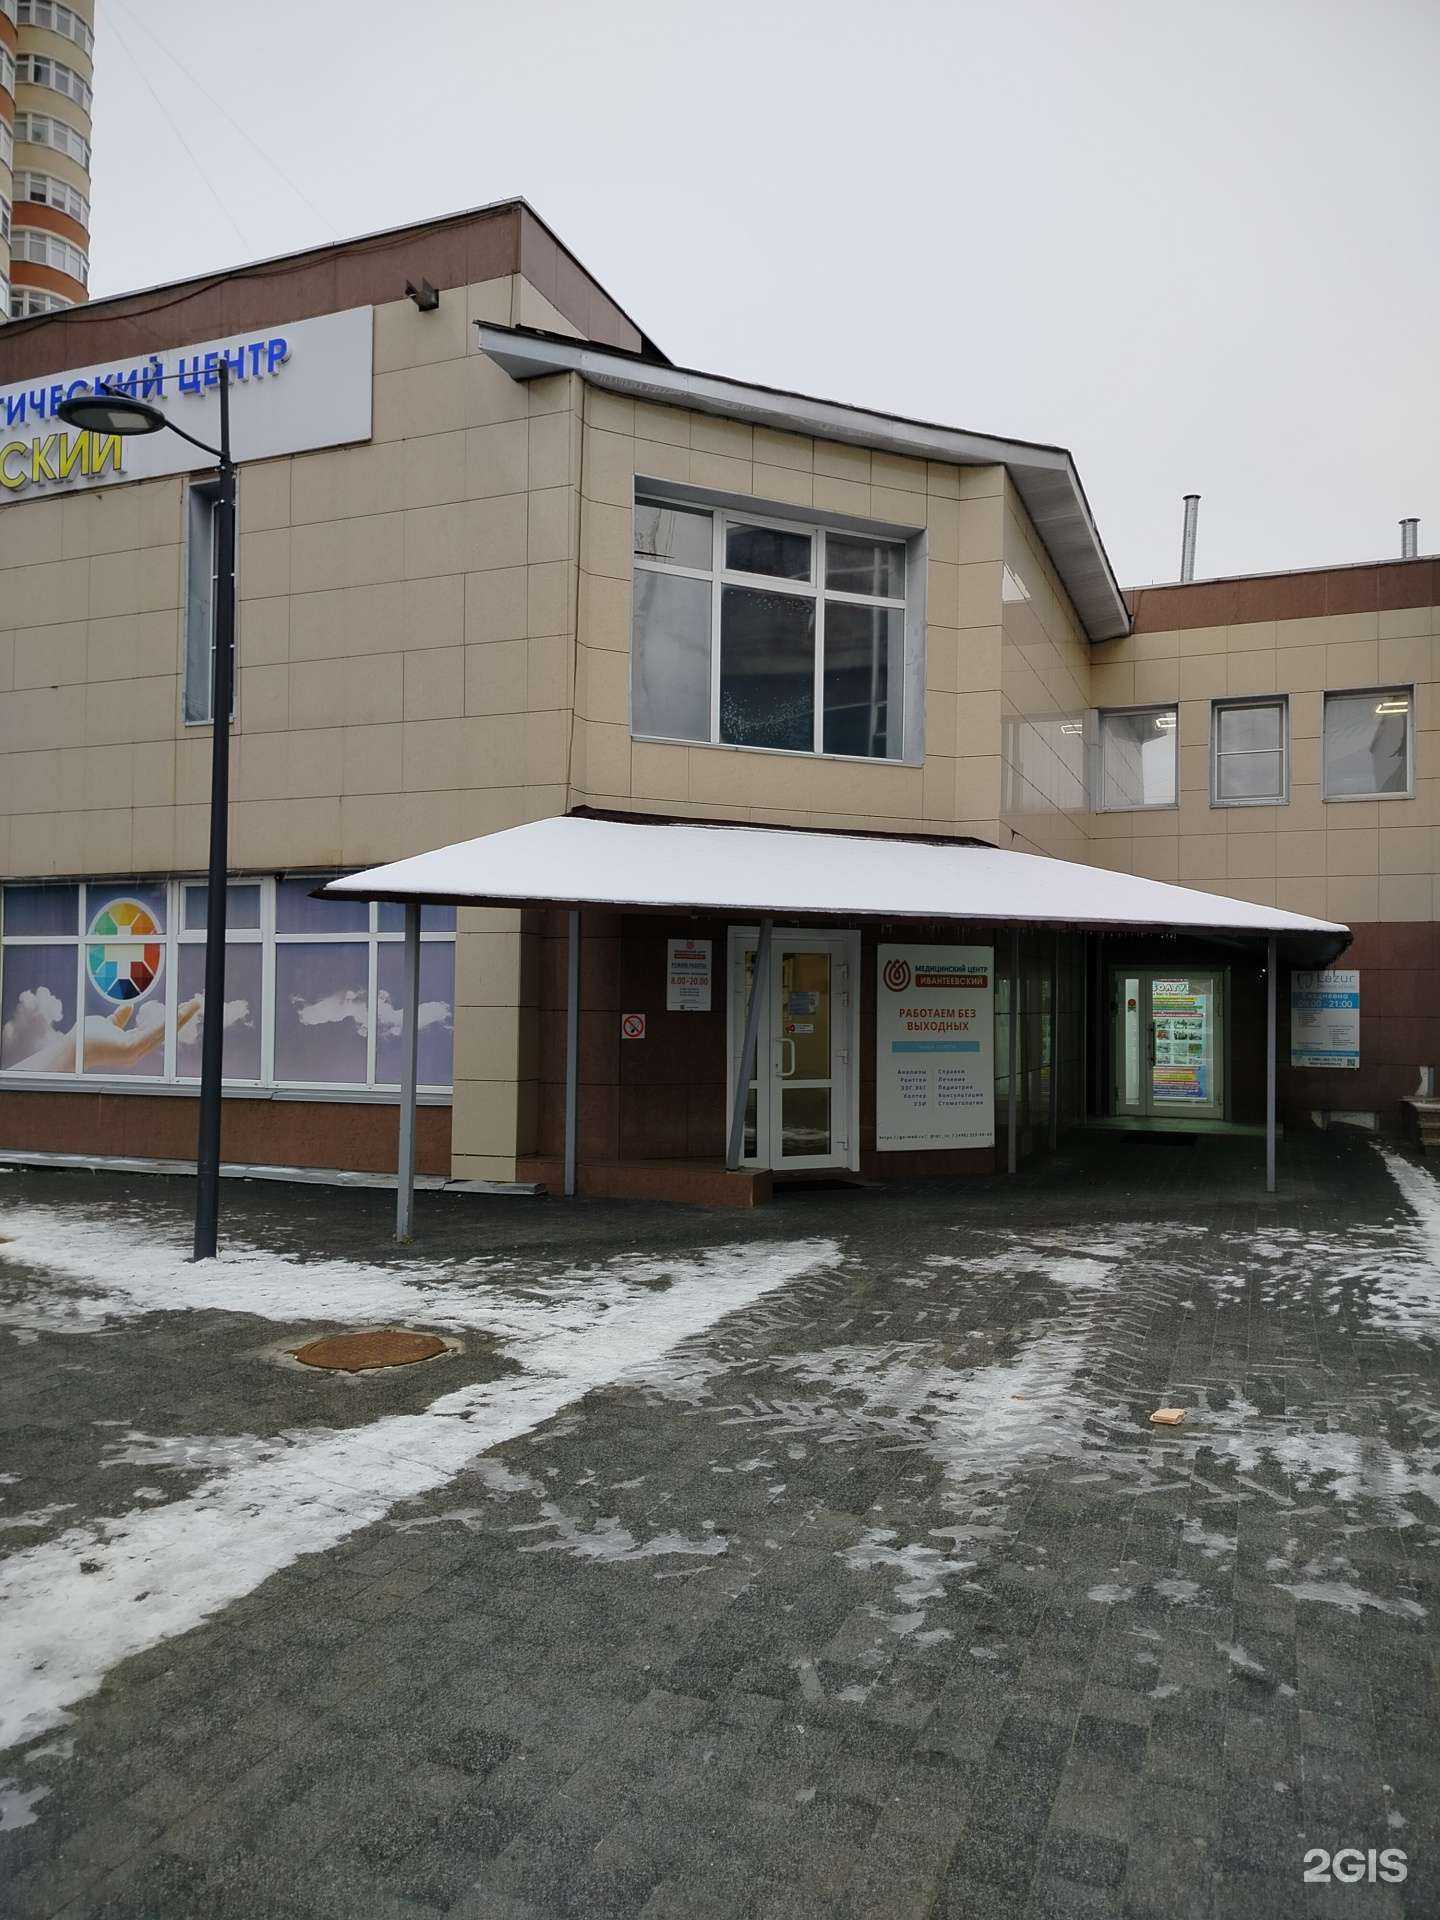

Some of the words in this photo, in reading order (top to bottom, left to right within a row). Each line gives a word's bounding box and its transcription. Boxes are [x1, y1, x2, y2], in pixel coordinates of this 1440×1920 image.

[0, 356, 163, 426] ИЧЕСКИЙ
[179, 338, 287, 393] ЦЕНТР
[915, 964, 966, 973] МЕДИЦИНСКИЙ
[967, 966, 988, 974] ЦЕНТР
[899, 1008, 955, 1018] РАБОТАЕМ
[958, 1009, 976, 1018] БЕЗ
[906, 1021, 969, 1032] ВЫХОДНЫХ
